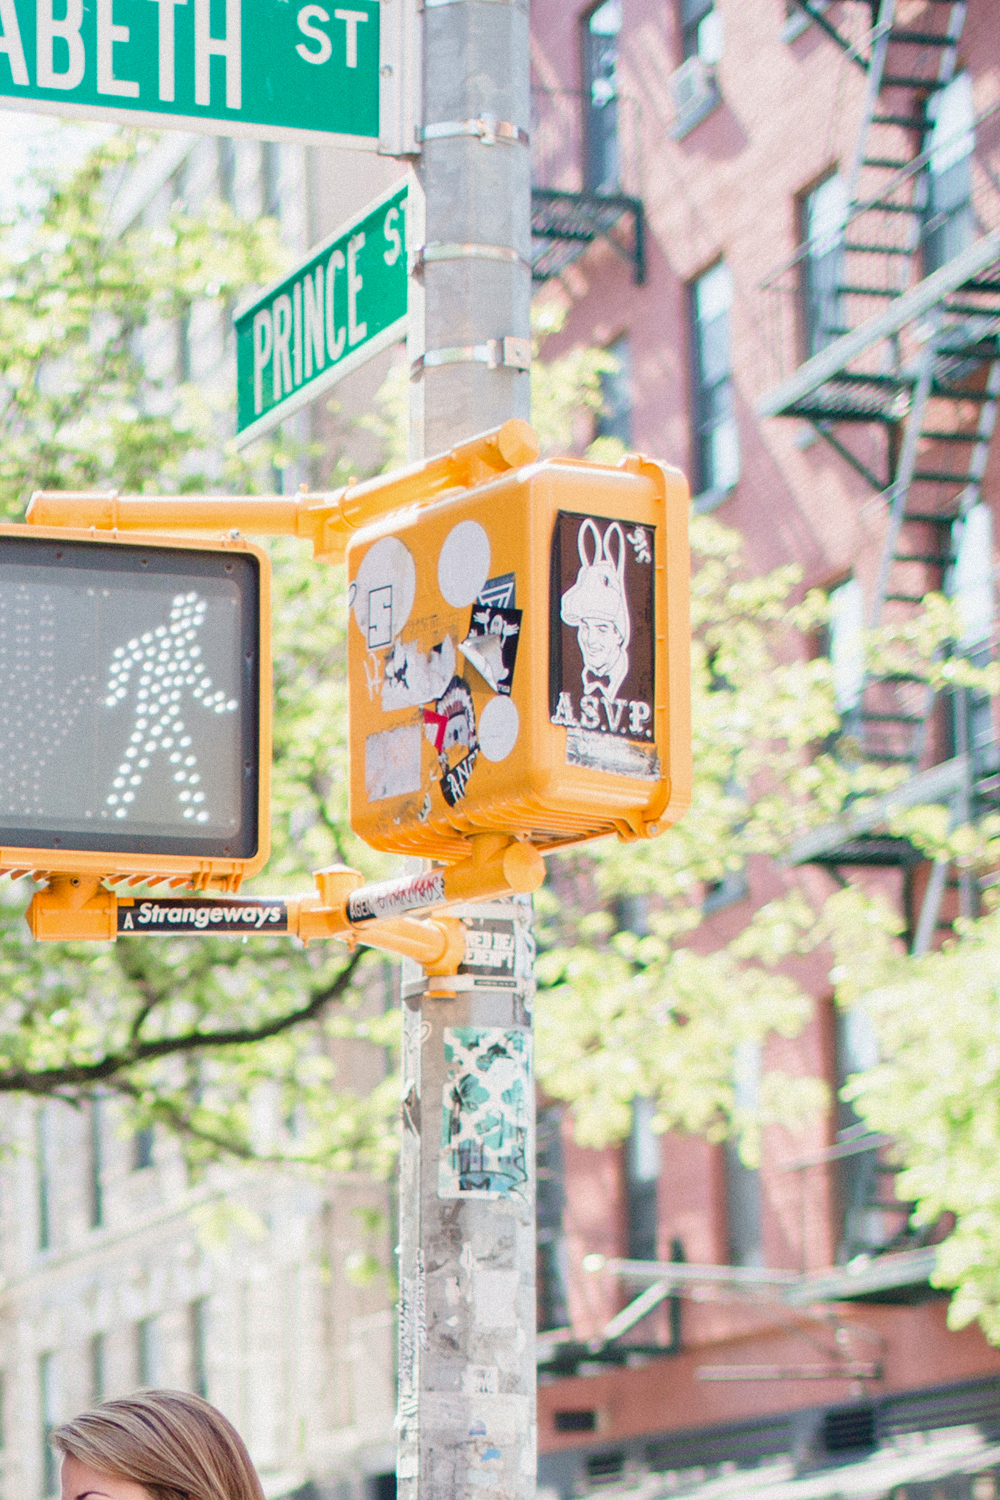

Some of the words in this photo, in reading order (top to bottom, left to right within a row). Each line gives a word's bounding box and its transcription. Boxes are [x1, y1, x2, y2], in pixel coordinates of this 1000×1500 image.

[295, 4, 369, 68] ST
[252, 231, 368, 416] PRINCE
[138, 902, 281, 929] Strangeways
